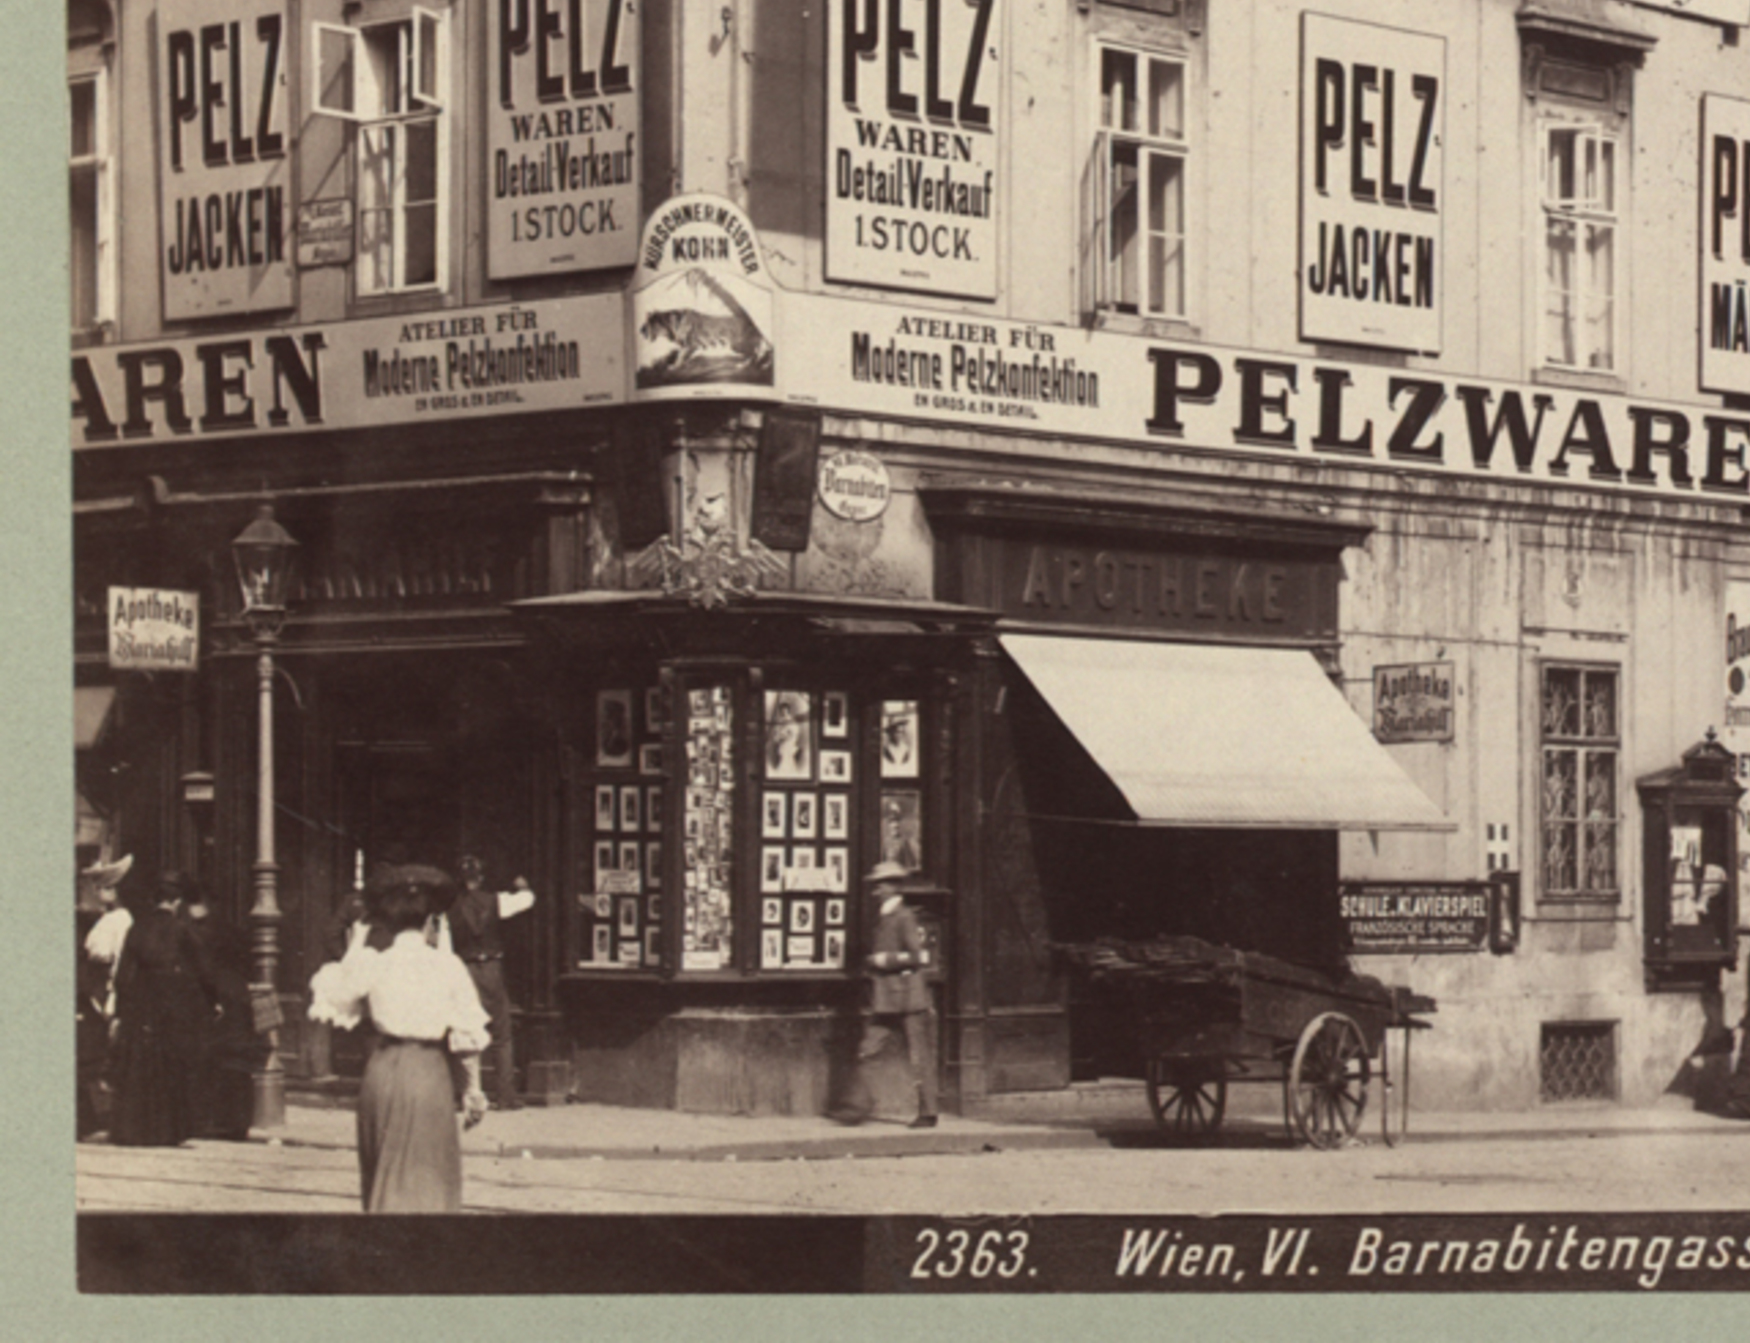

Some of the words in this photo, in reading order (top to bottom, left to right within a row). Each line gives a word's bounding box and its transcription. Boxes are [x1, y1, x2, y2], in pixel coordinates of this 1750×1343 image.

[168, 13, 285, 173] PELZ
[1314, 57, 1439, 214] PELZ
[168, 186, 285, 275] JACKEN
[1309, 221, 1434, 309] JACKEN
[399, 316, 486, 343] ATELIER
[496, 306, 537, 332] FÜR
[897, 316, 999, 345] ATELIER
[1009, 326, 1055, 351] FÜR
[363, 348, 441, 398] Moderne
[446, 331, 580, 391] Pelzkonfektion
[852, 331, 945, 390] Moderne
[950, 344, 1098, 408] Pelzkonfektion
[114, 590, 193, 630] Apotheke
[1022, 545, 1284, 623] APOTHEKE
[1378, 666, 1449, 706] Apotheke
